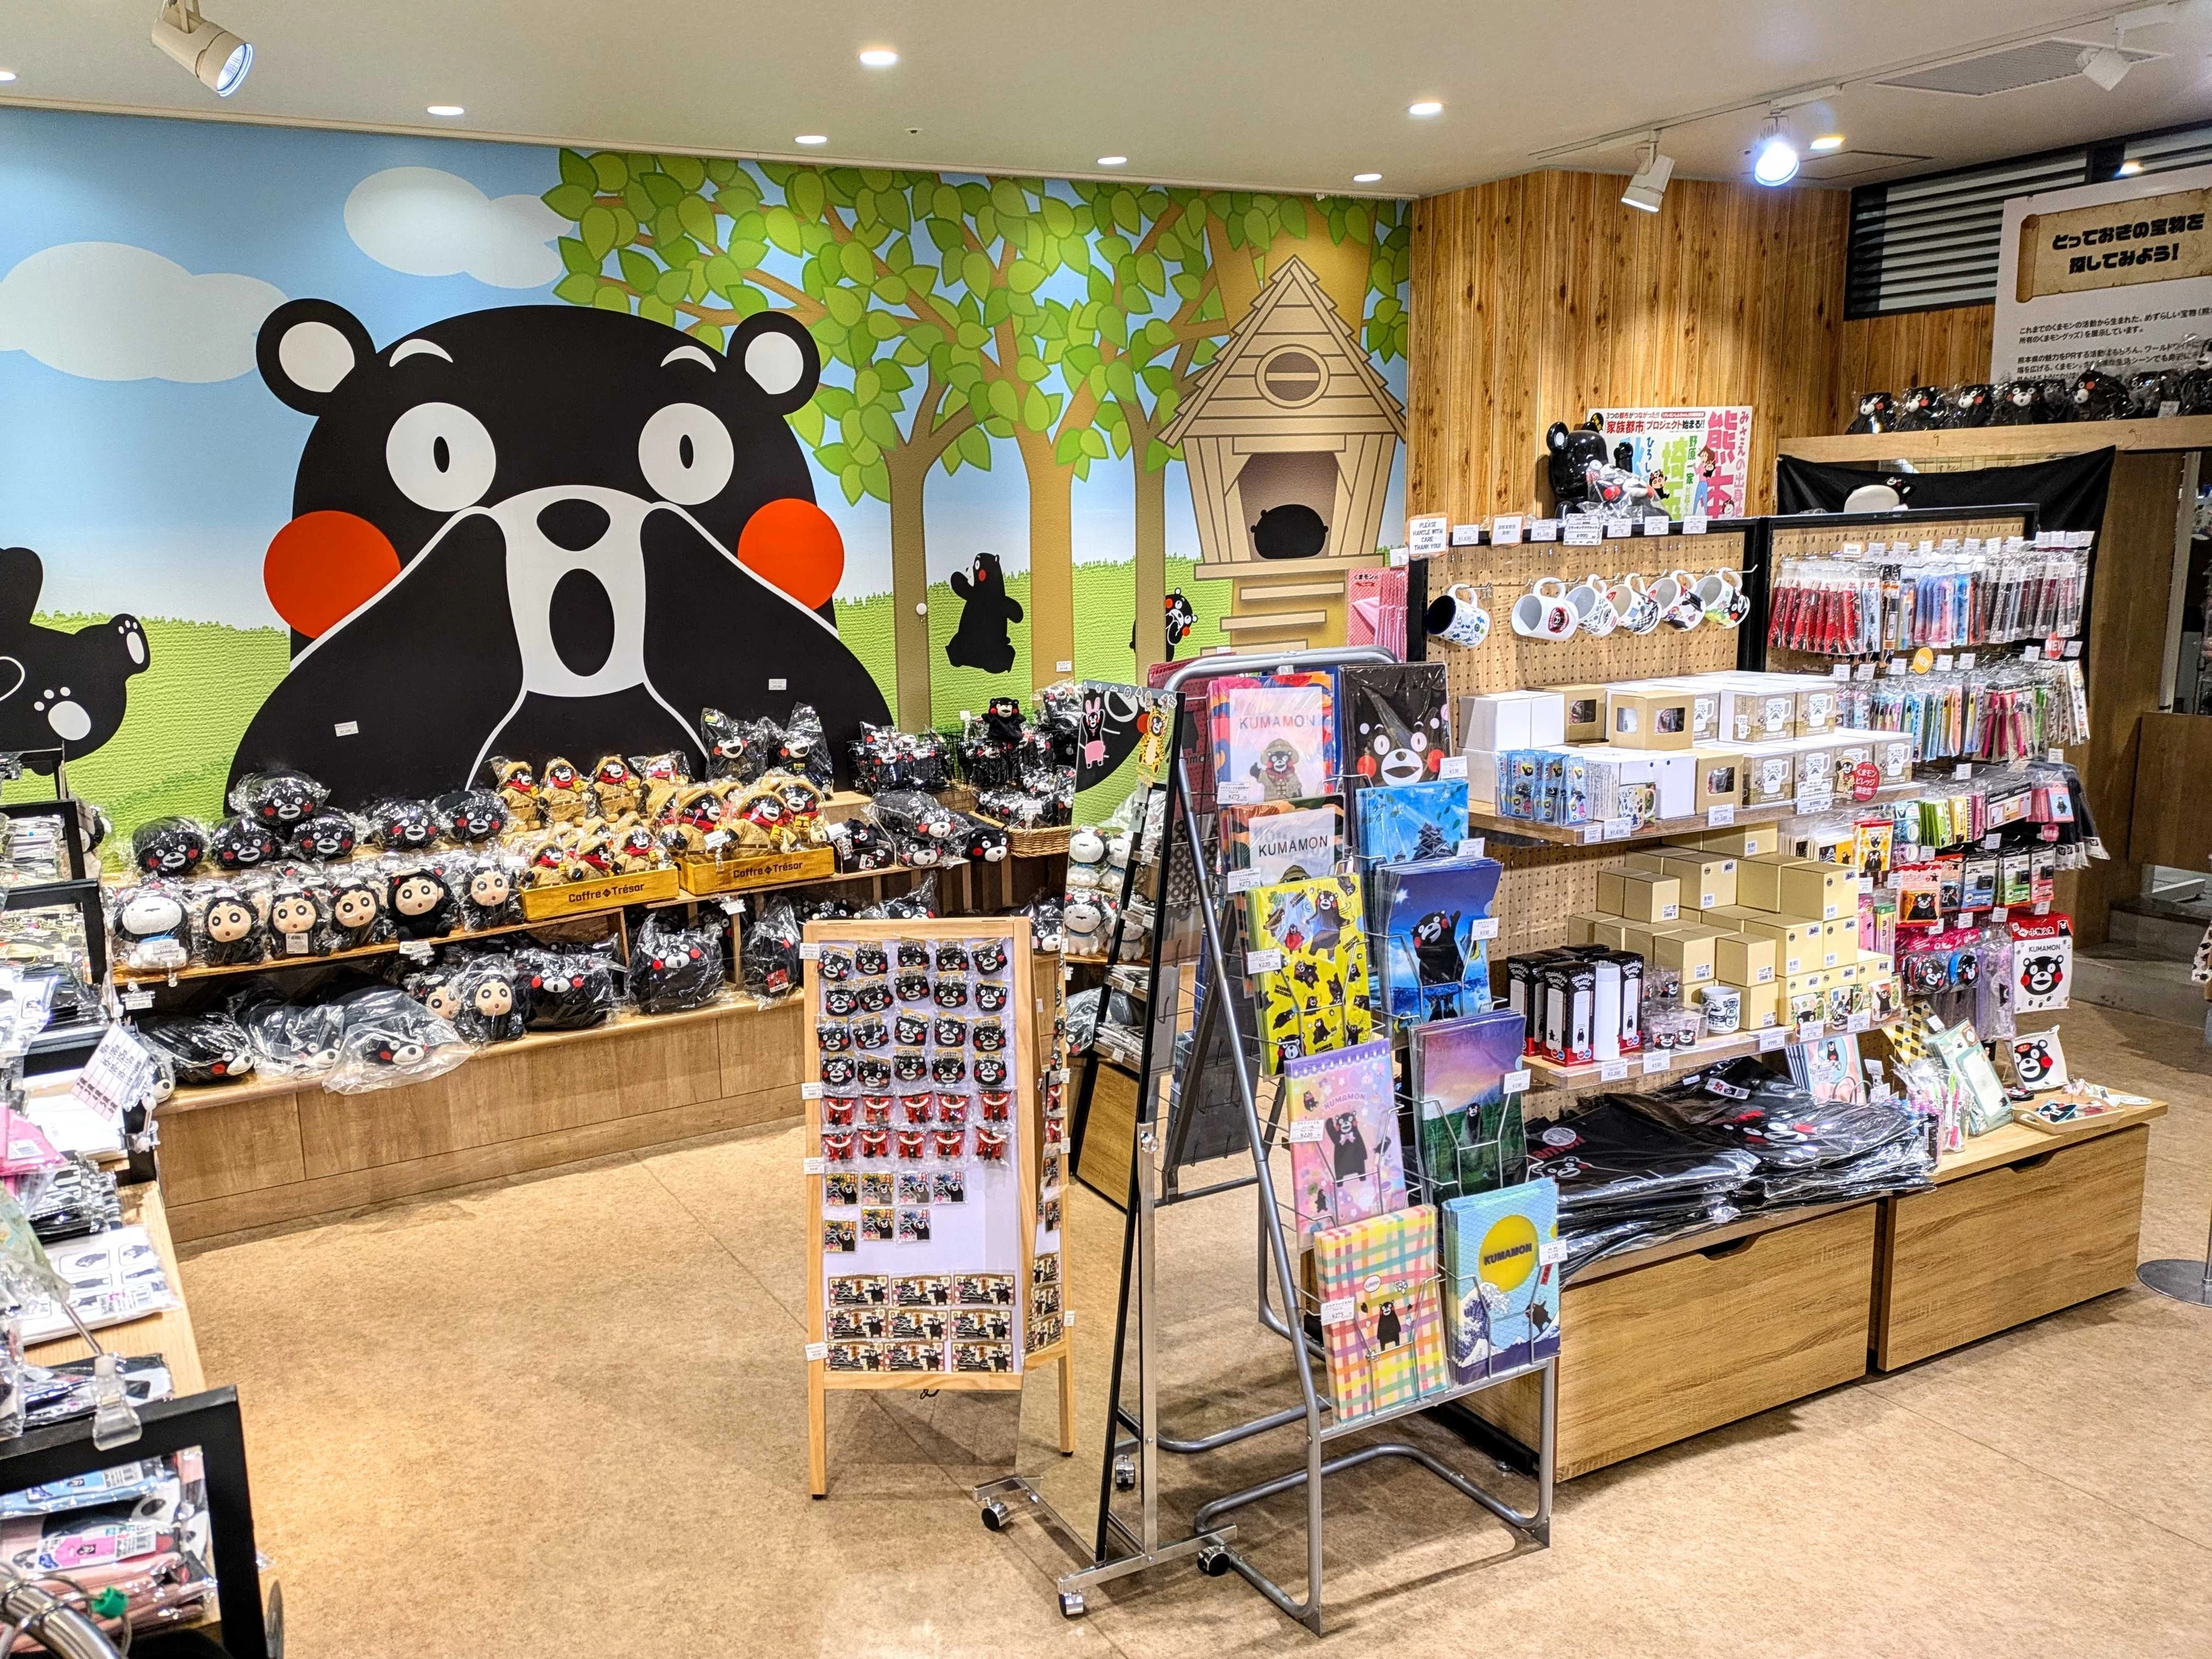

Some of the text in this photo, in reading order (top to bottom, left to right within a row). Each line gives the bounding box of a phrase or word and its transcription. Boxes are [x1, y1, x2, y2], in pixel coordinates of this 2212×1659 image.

[2052, 214, 2205, 250] とっておきの宝物を
[1705, 411, 1738, 519] 熊本
[2047, 640, 2066, 652] NEW
[1917, 655, 1930, 667] NEW
[1239, 714, 1315, 729] KUMAMON
[1857, 768, 1877, 778] くまモン
[1855, 777, 1876, 787] ビレッジ
[1259, 835, 1328, 858] KUMAMON
[733, 862, 803, 878] Coffre Trésor
[568, 890, 601, 902] Coffre
[611, 884, 645, 895] Trésor
[2028, 945, 2061, 953] KUMAMON
[1622, 960, 1643, 973] Stainless
[1545, 971, 1568, 984] Stainless
[1571, 972, 1595, 984] Stainless
[1574, 979, 1591, 988] Bottle
[1324, 1093, 1366, 1110] KUMAMON
[1484, 1243, 1532, 1266] KUMAMON
